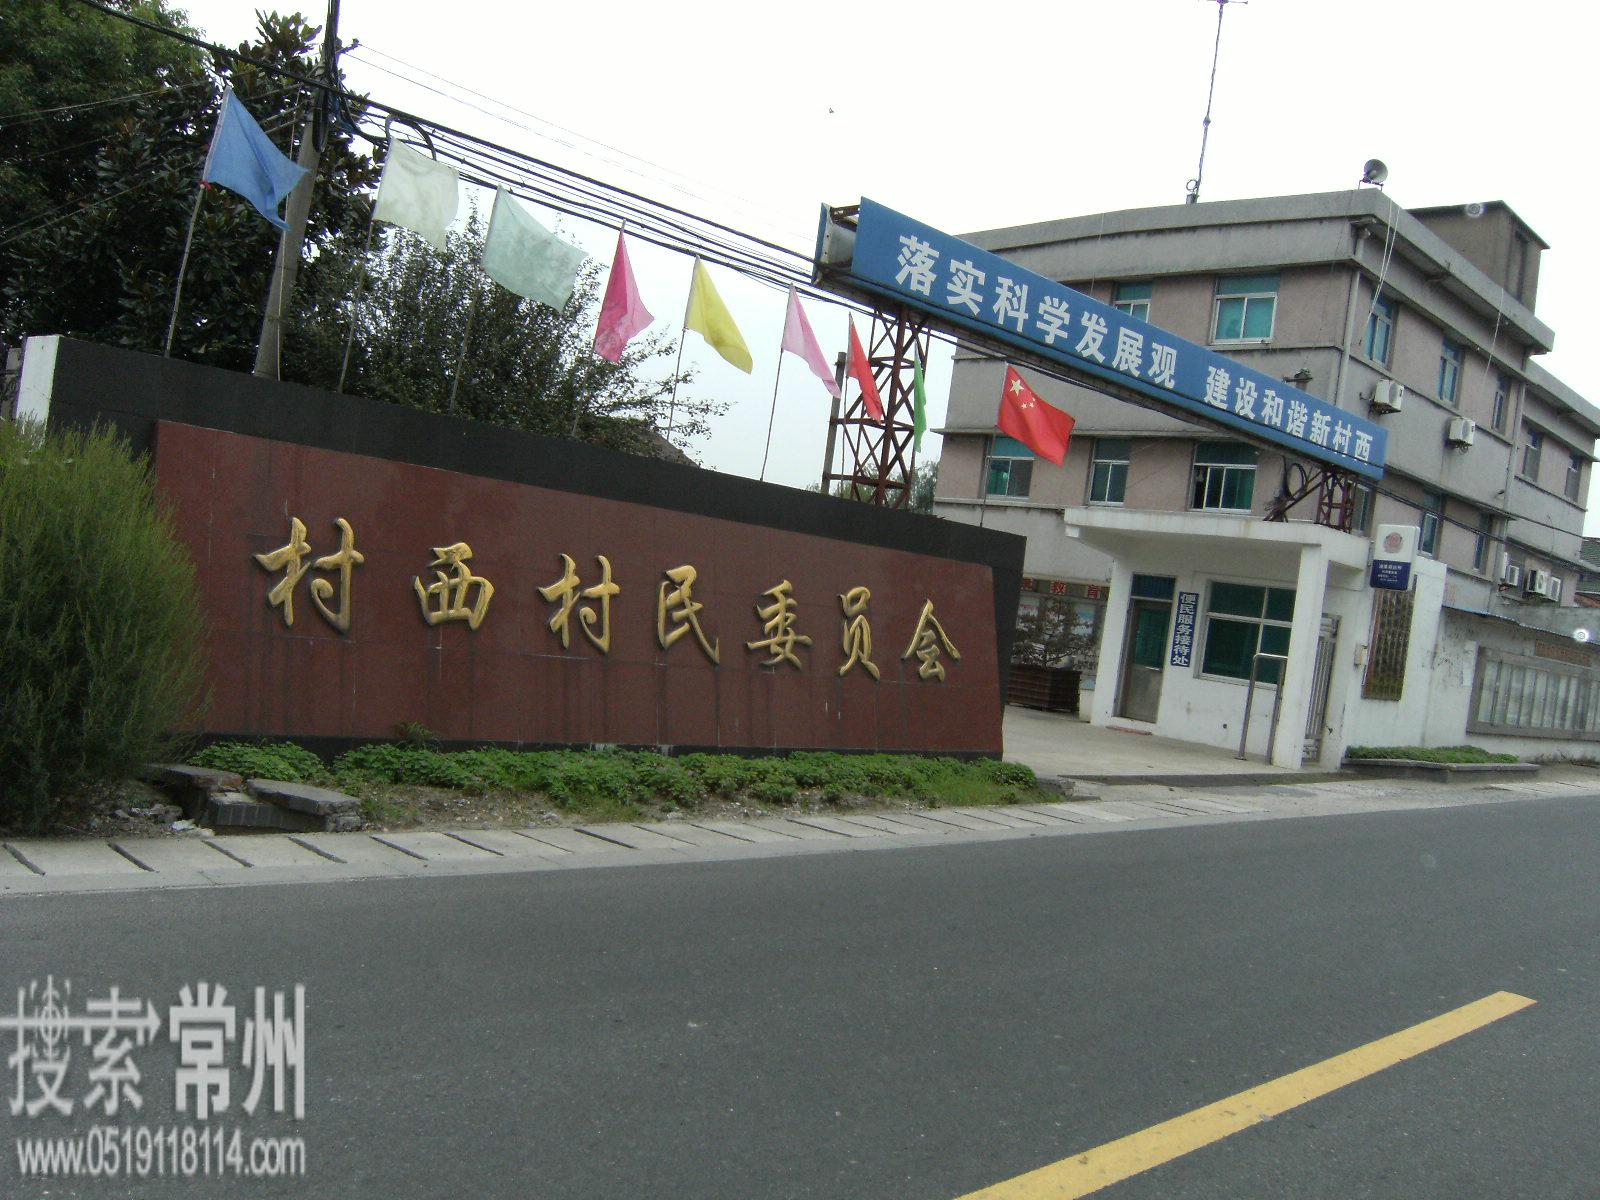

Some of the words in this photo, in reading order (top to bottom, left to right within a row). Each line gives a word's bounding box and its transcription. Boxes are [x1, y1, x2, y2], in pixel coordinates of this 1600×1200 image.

[897, 234, 1178, 390] 落实科学发展观
[1203, 364, 1375, 466] 建设和谐新村西
[252, 516, 962, 683] 村西村民委员会
